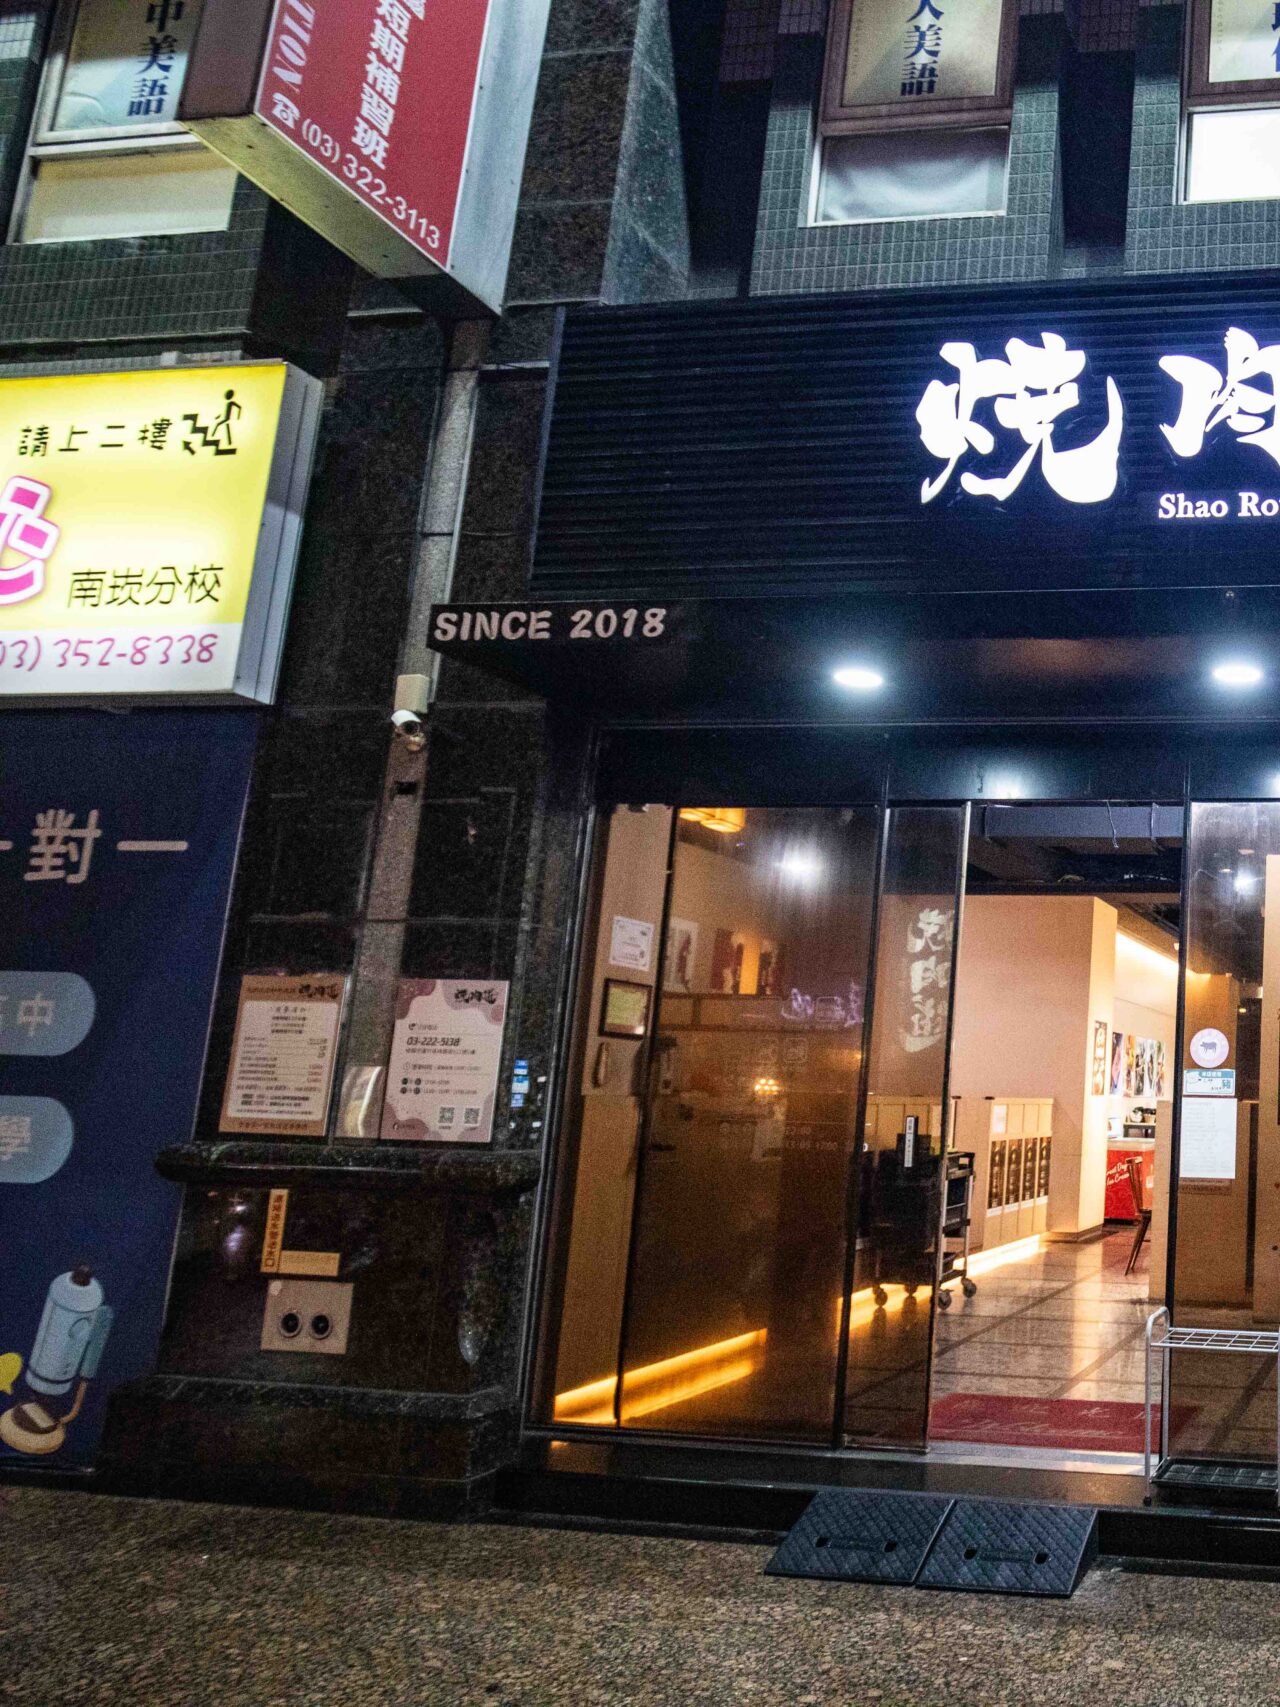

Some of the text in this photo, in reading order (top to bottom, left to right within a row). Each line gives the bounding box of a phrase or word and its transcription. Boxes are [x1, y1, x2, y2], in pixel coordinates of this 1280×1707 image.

[301, 118, 441, 249] (03) 322-3113
[18, 417, 173, 458] 請上二樓
[1158, 493, 1229, 520] Shao
[67, 564, 225, 609] 南崁分校
[434, 607, 667, 642] SINCE 2018
[54, 633, 219, 668] 352-8338
[0, 808, 189, 884] 對一
